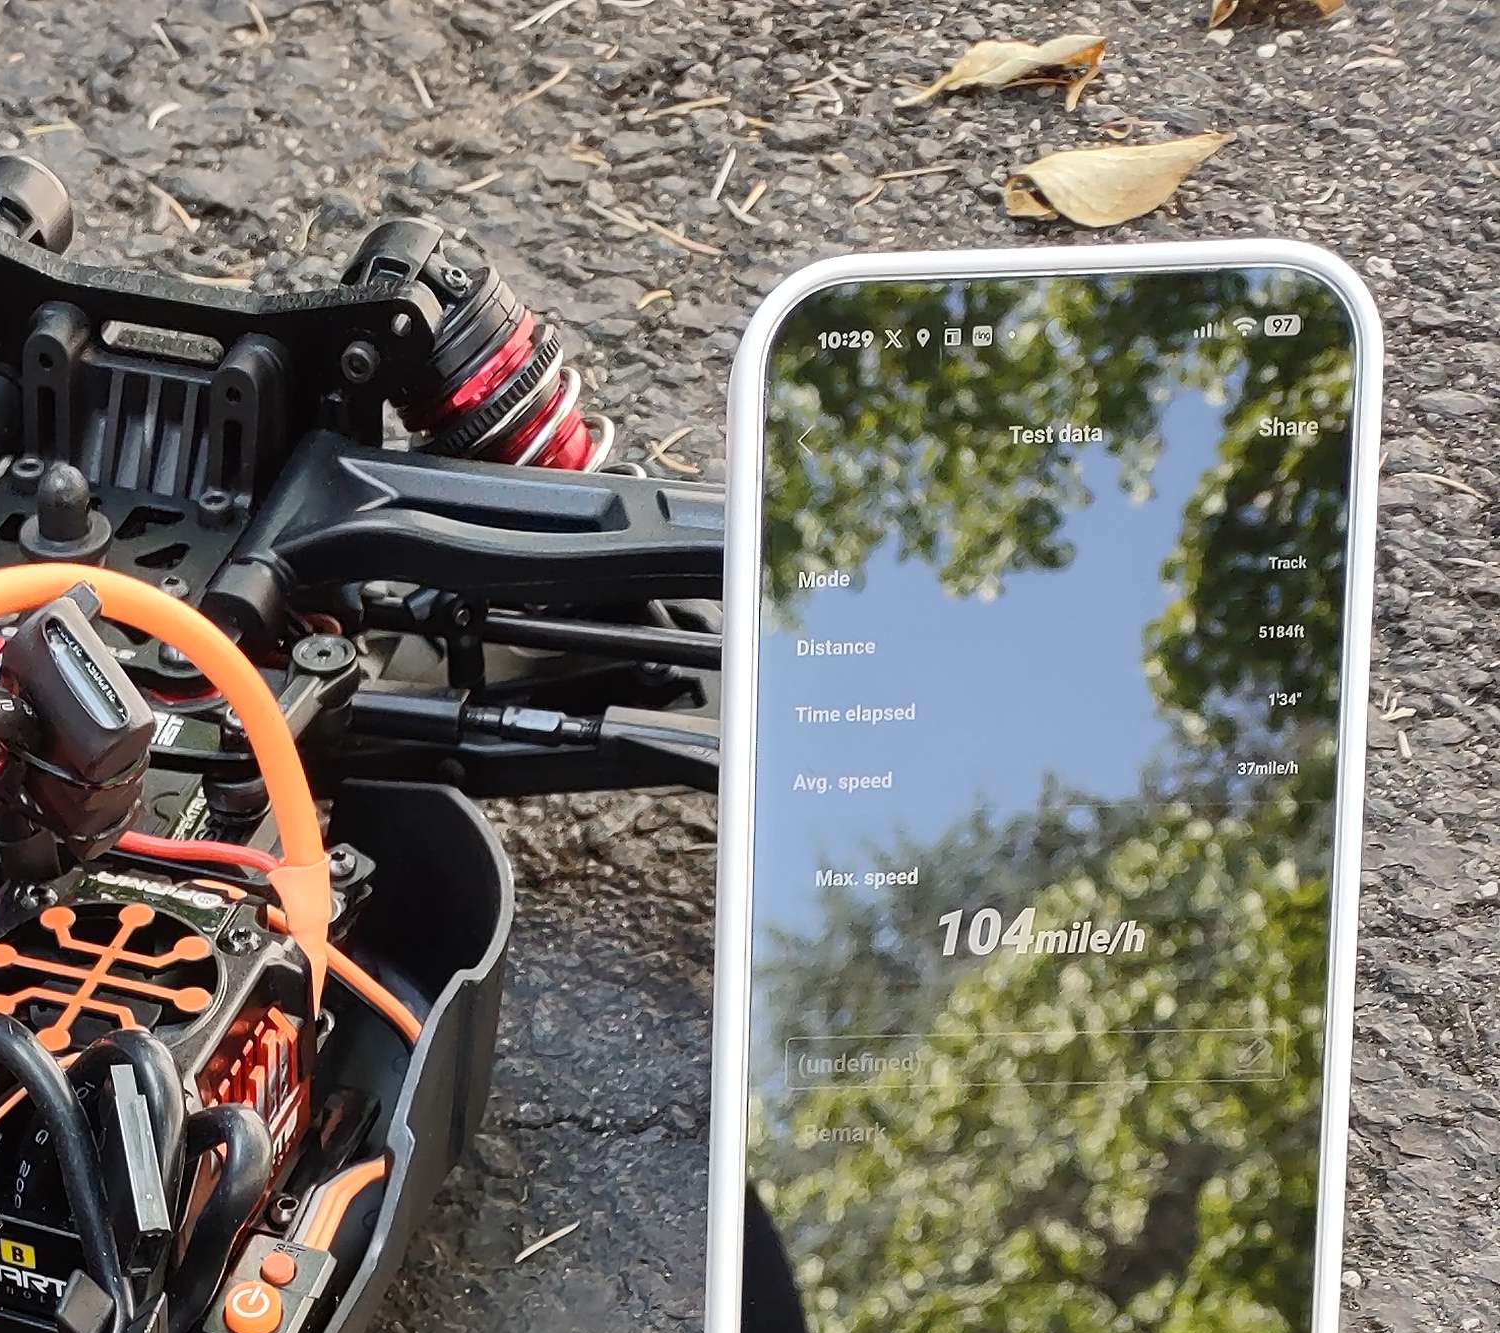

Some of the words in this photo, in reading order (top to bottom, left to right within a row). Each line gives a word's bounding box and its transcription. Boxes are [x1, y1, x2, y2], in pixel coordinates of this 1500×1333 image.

[1271, 317, 1294, 334] 97
[817, 329, 875, 350] 10:29
[1009, 425, 1051, 445] Test
[1055, 423, 1103, 443] data
[1258, 417, 1319, 437] Share
[1268, 555, 1307, 571] Track
[798, 570, 850, 589] Mode
[1258, 623, 1305, 640] 5184ft
[797, 639, 876, 657] Distance
[796, 705, 840, 723] Time
[845, 703, 916, 725] elapsed
[1237, 760, 1299, 777] 37mile/h
[793, 773, 833, 793] Avg.
[838, 771, 893, 793] speed
[815, 869, 859, 888] Max.
[864, 867, 919, 889] speed
[938, 907, 1146, 957] 104mile/h
[798, 1051, 923, 1078] (undefined)
